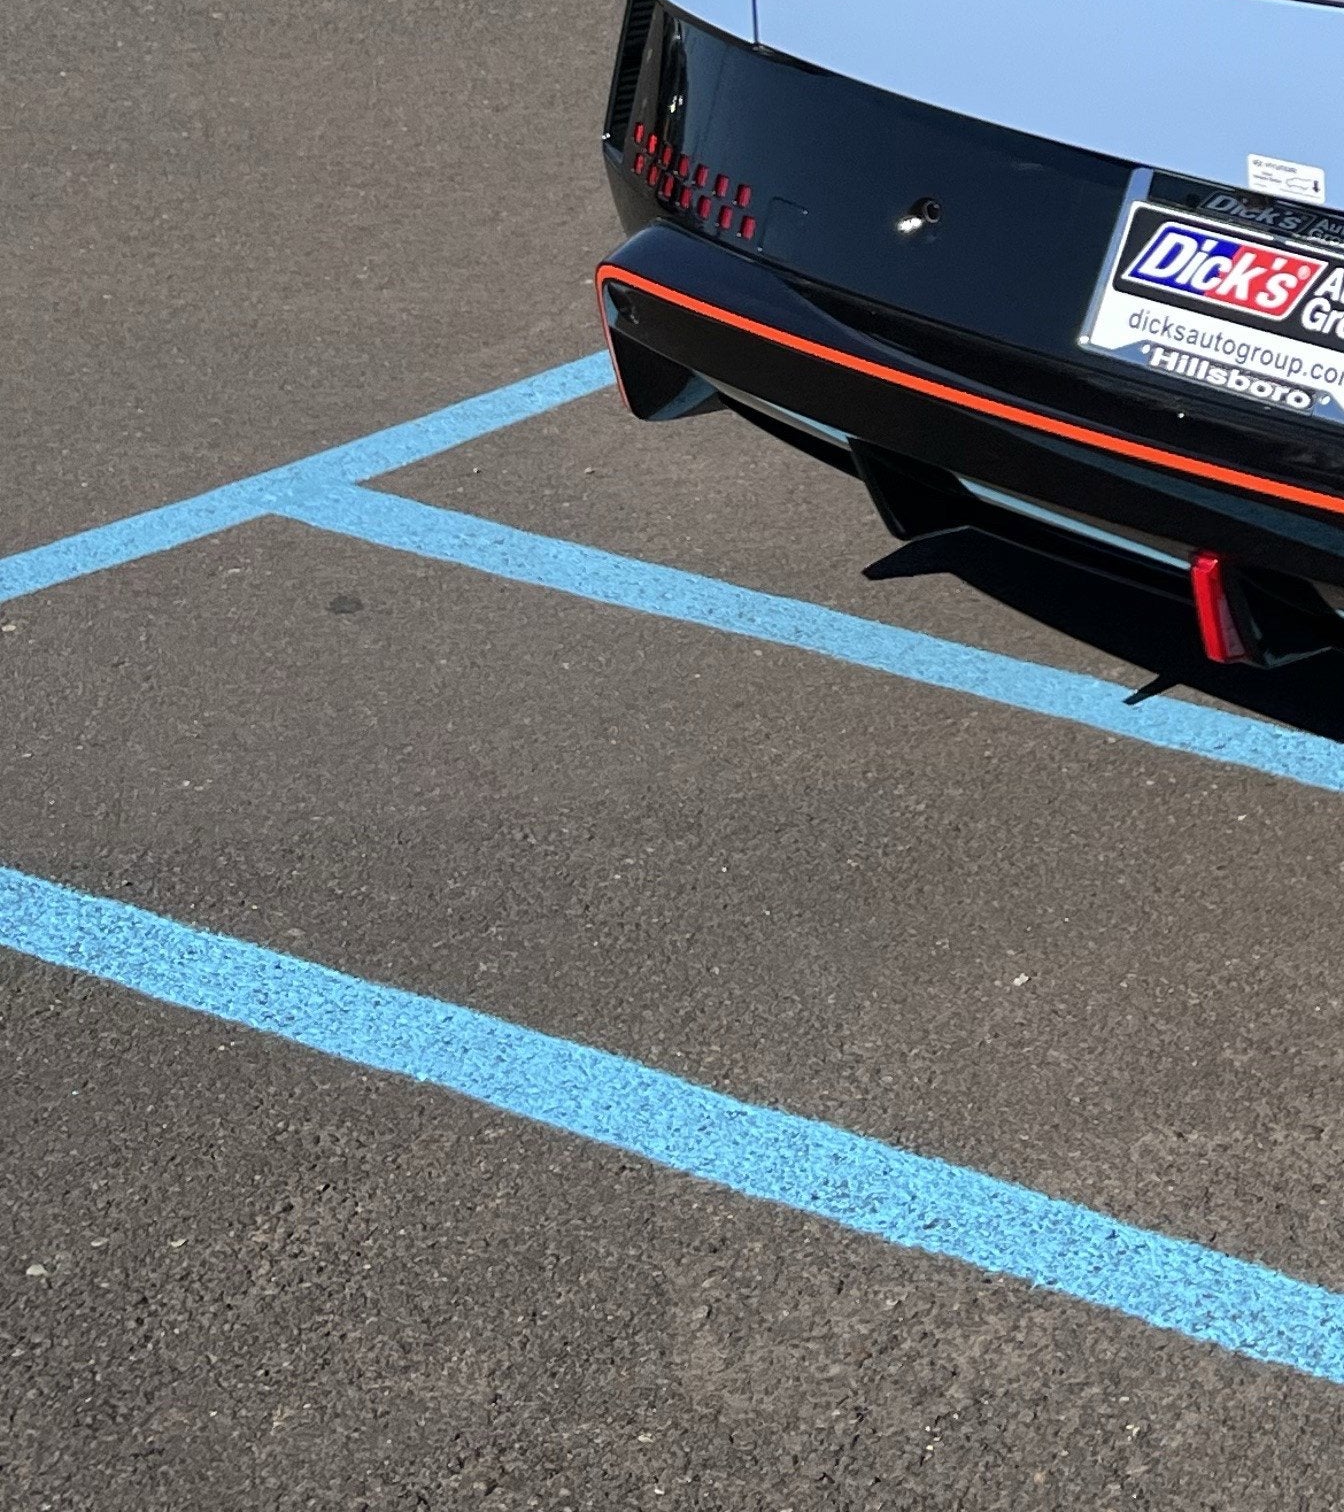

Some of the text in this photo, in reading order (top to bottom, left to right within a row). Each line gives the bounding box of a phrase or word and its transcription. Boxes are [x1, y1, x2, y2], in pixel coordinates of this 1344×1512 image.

[1207, 194, 1302, 231] Dick's
[1139, 233, 1298, 310] Dick's
[1149, 345, 1312, 409] Hillsboro
